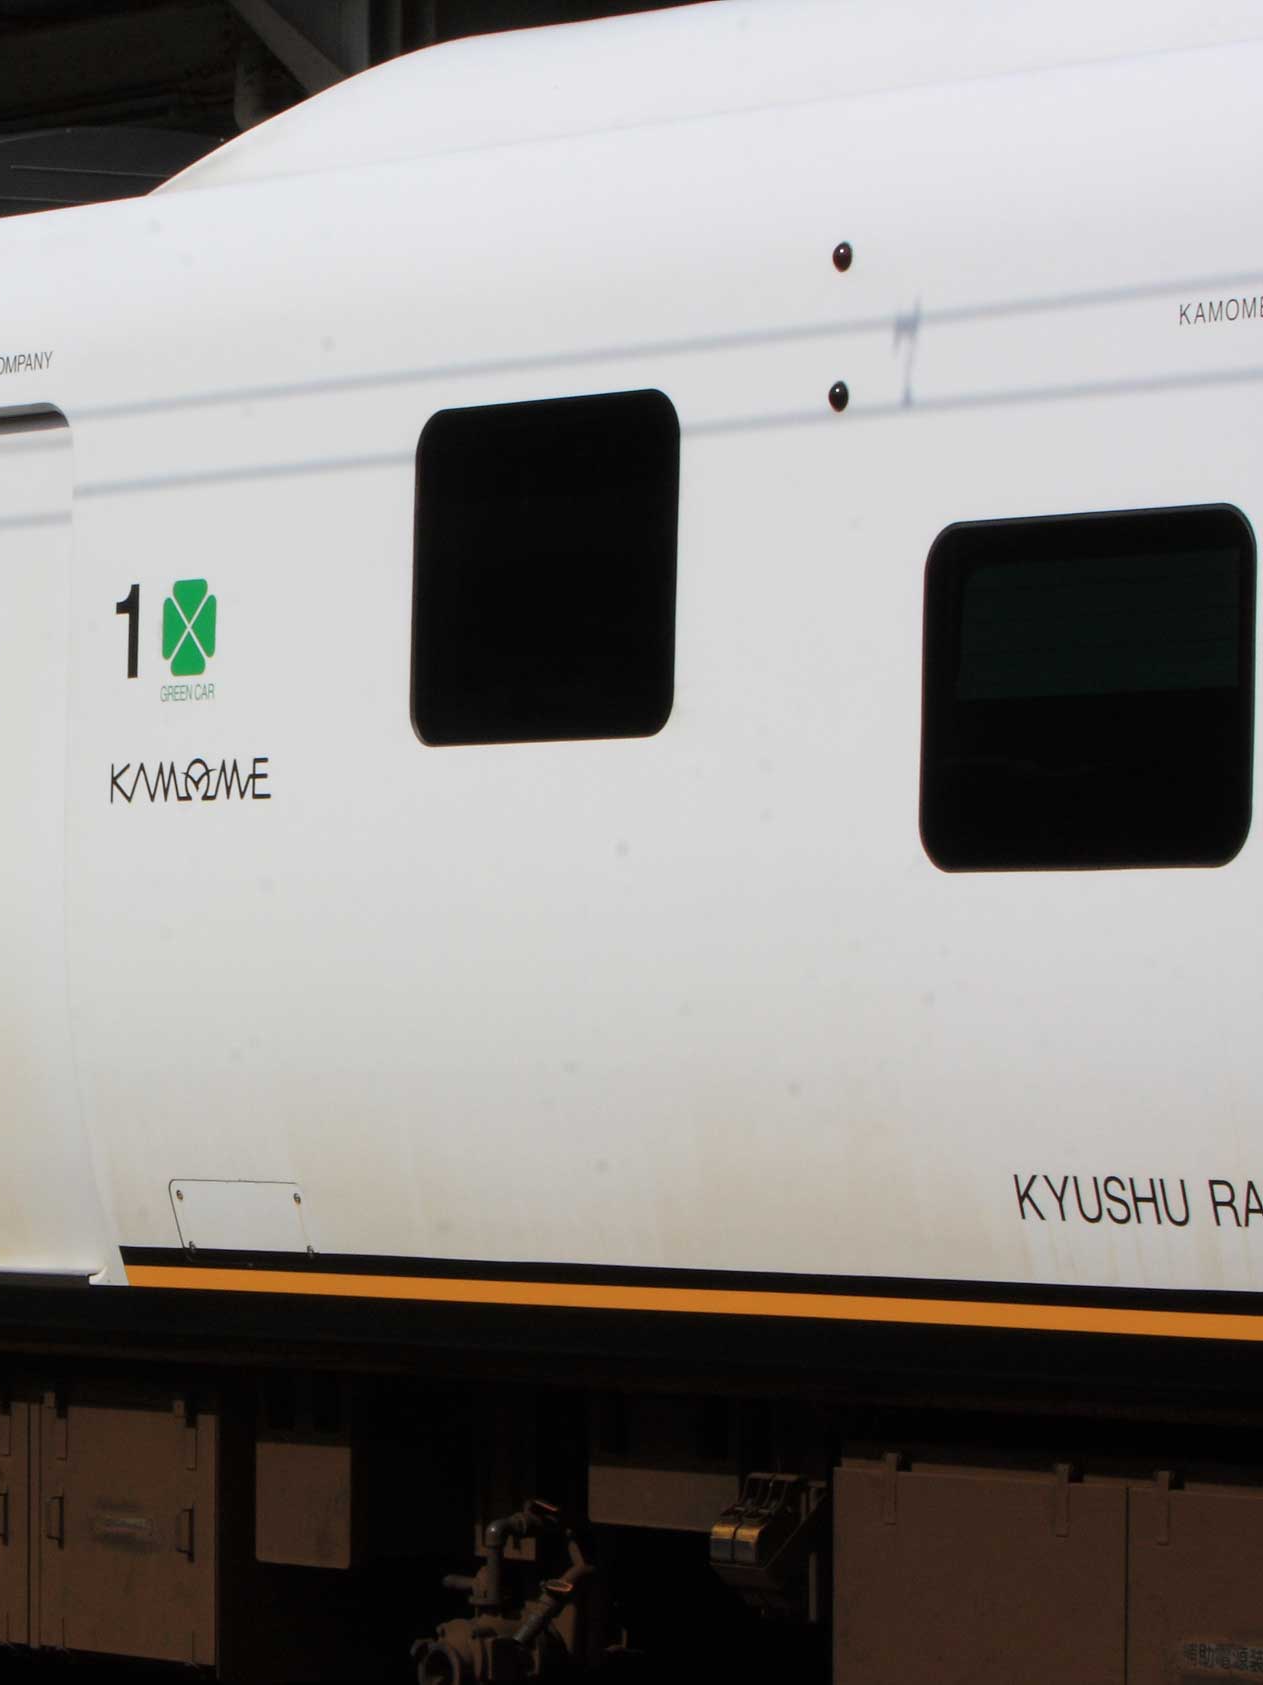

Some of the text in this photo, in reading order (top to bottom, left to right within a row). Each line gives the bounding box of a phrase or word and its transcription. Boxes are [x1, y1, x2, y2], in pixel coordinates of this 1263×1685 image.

[116, 584, 140, 679] 1
[160, 683, 215, 702] GREEN CAR
[110, 757, 271, 804] KAMOME
[1013, 1174, 1190, 1227] KYUSHU
